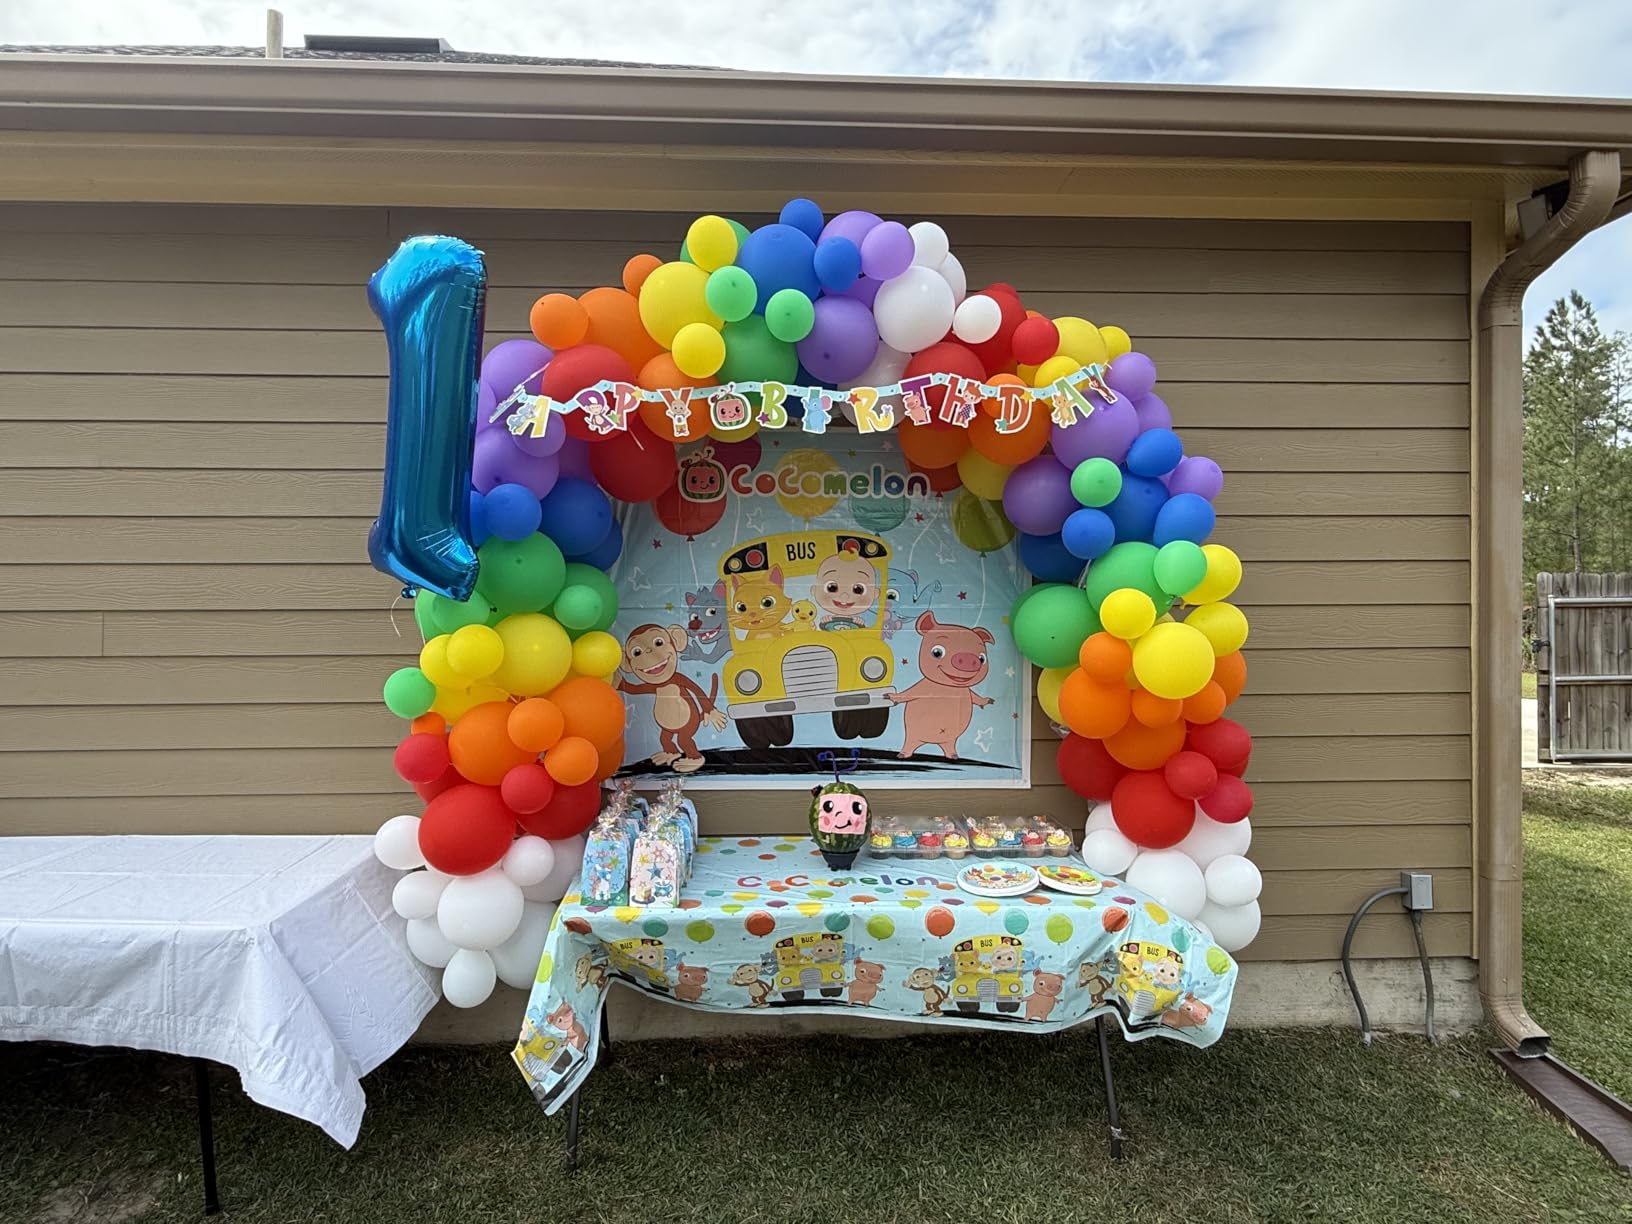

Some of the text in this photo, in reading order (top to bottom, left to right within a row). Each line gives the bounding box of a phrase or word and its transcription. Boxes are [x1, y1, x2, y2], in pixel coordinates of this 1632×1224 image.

[489, 382, 694, 438] APPY
[786, 542, 816, 561] BUS
[801, 936, 813, 944] BUS
[980, 939, 993, 948] BUS
[1146, 946, 1160, 957] BUS
